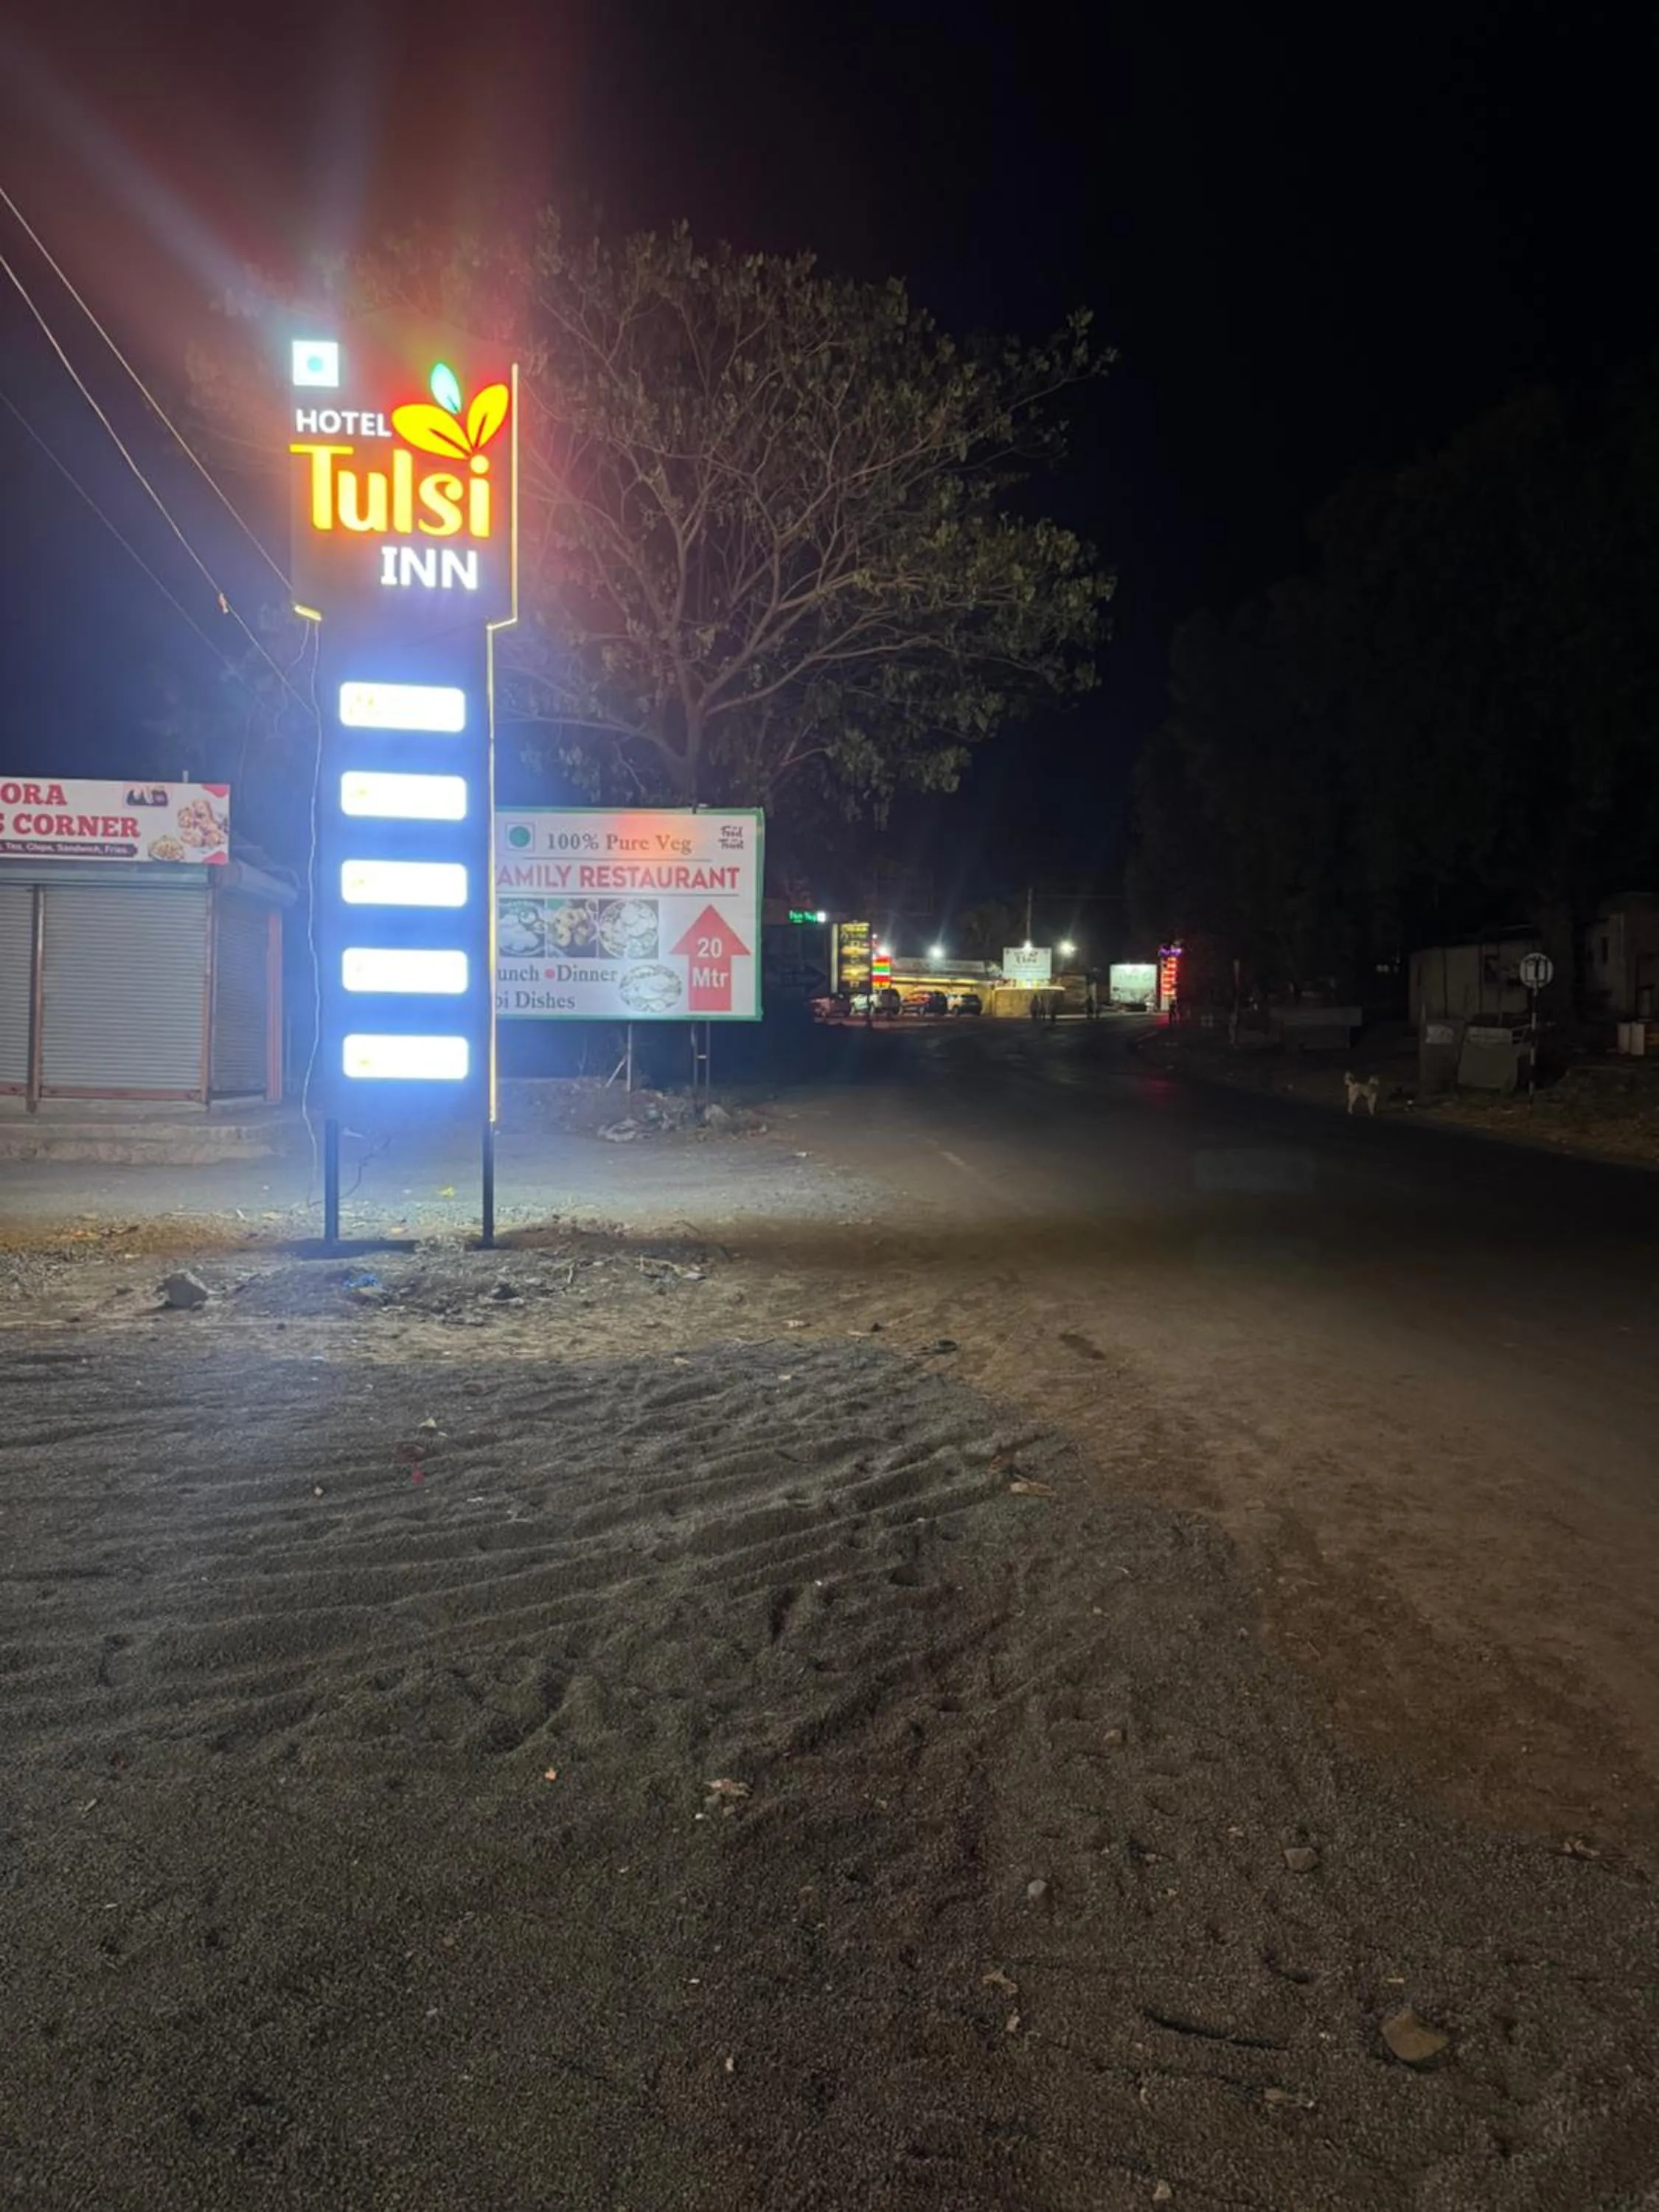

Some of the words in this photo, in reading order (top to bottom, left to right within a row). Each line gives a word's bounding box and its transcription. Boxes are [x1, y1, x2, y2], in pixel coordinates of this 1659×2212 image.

[296, 408, 392, 437] HOTEL
[289, 443, 490, 538] Tulsi
[380, 546, 477, 590] INN
[13, 813, 140, 838] CORNER
[547, 833, 599, 850] 100%
[606, 834, 649, 851] Pure
[655, 835, 692, 855] Veg
[495, 865, 572, 888] AMILY
[580, 866, 740, 889] RESTAURANT
[698, 938, 723, 958] 20
[498, 964, 539, 981] unch
[556, 964, 617, 982] Dinner
[692, 970, 728, 988] Mtr
[515, 990, 576, 1009] Dishes
